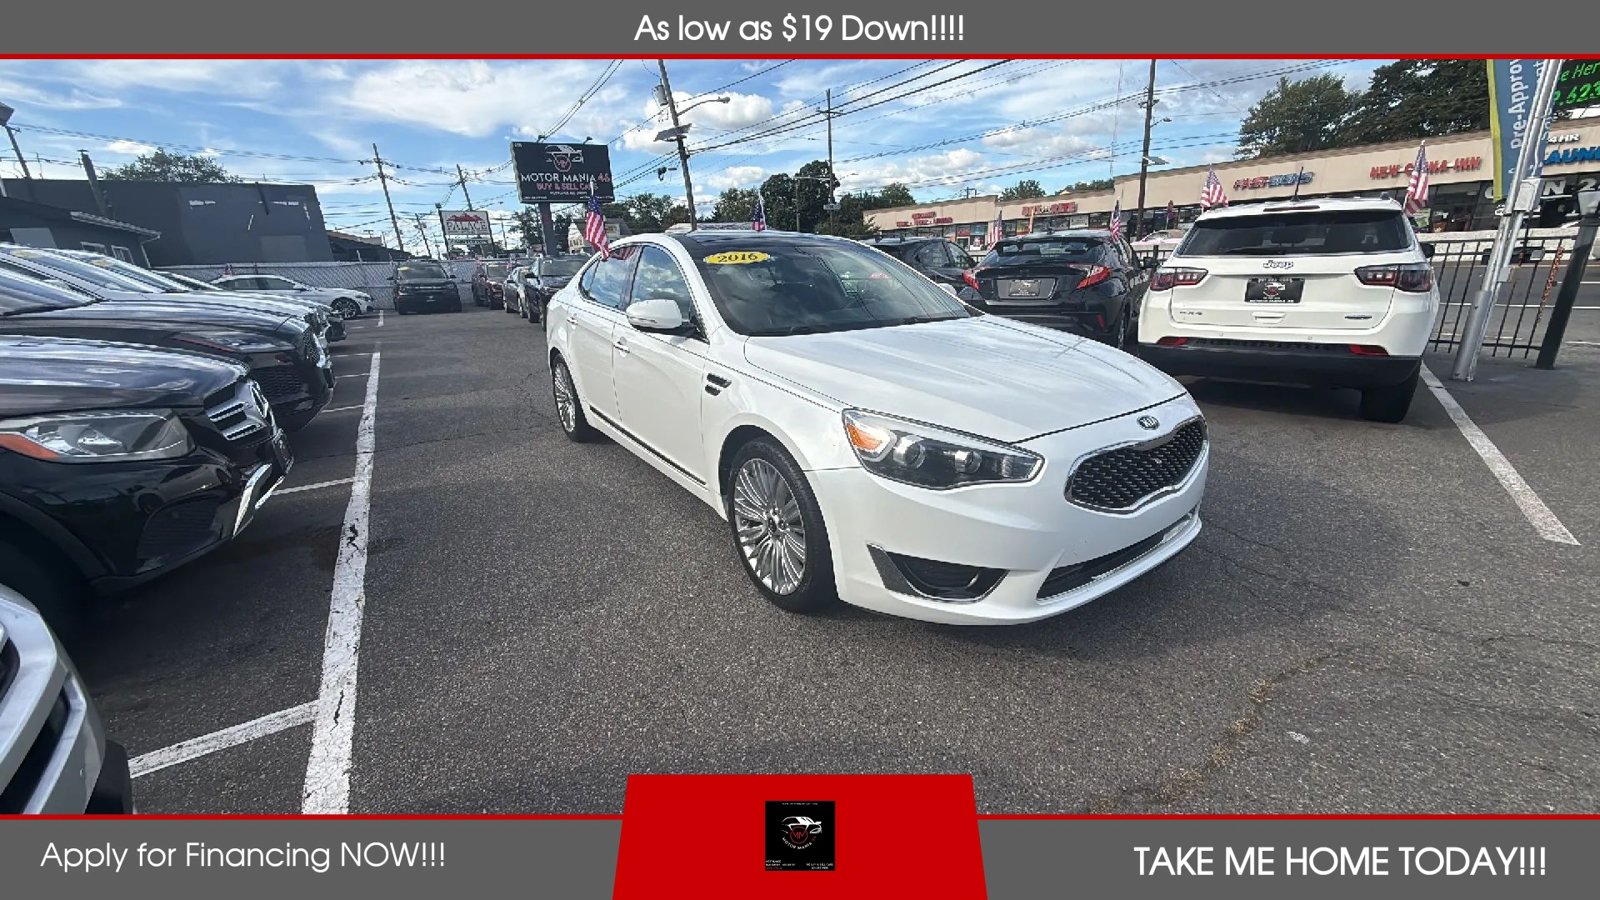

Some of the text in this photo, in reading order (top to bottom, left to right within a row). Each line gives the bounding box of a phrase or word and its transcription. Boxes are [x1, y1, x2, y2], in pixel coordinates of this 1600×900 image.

[1369, 164, 1401, 180] NEW
[521, 172, 560, 183] MOTOR
[562, 173, 597, 183] MANIA
[536, 182, 552, 191] BUY
[562, 182, 579, 191] SELL
[446, 221, 487, 231] PALACE
[717, 253, 759, 263] 2016
[1263, 259, 1294, 269] Jeep
